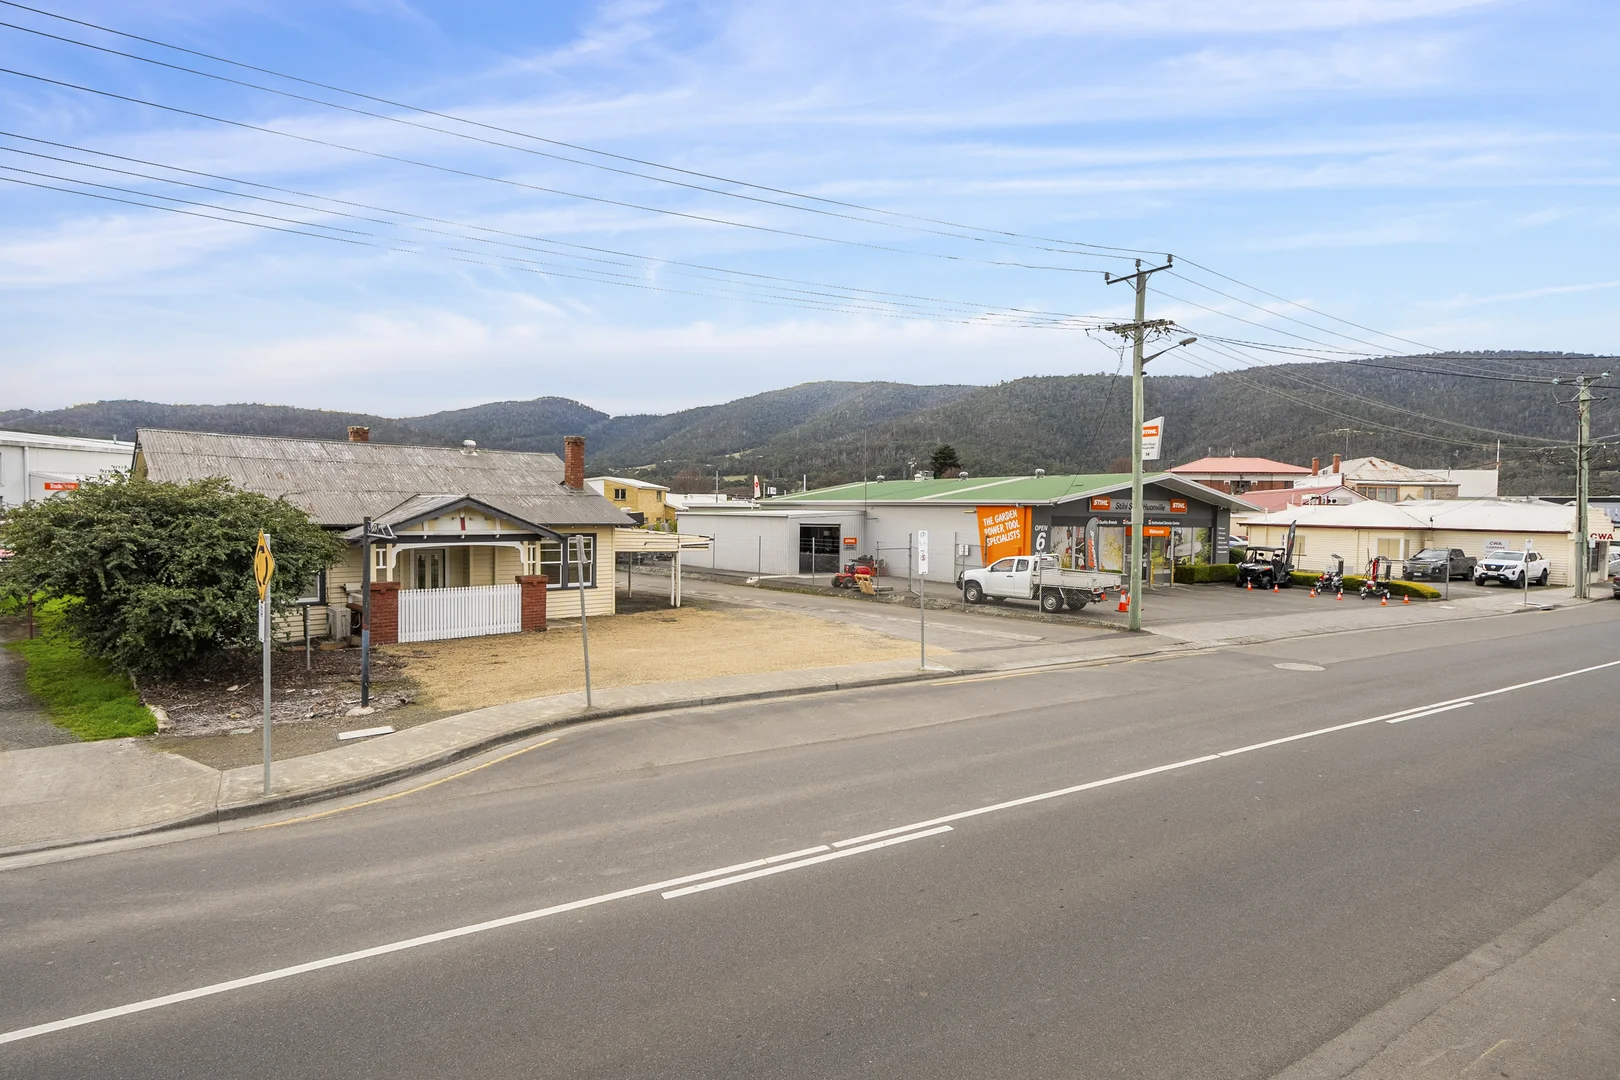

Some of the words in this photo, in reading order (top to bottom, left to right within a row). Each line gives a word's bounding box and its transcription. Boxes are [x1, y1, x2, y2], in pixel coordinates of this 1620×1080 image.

[983, 518, 994, 526] THE
[994, 509, 1018, 523] GARDEN
[984, 524, 1006, 536] POWER
[1005, 519, 1020, 530] TOOL
[986, 530, 1021, 547] SPECIALISTS
[1035, 532, 1047, 551] 6
